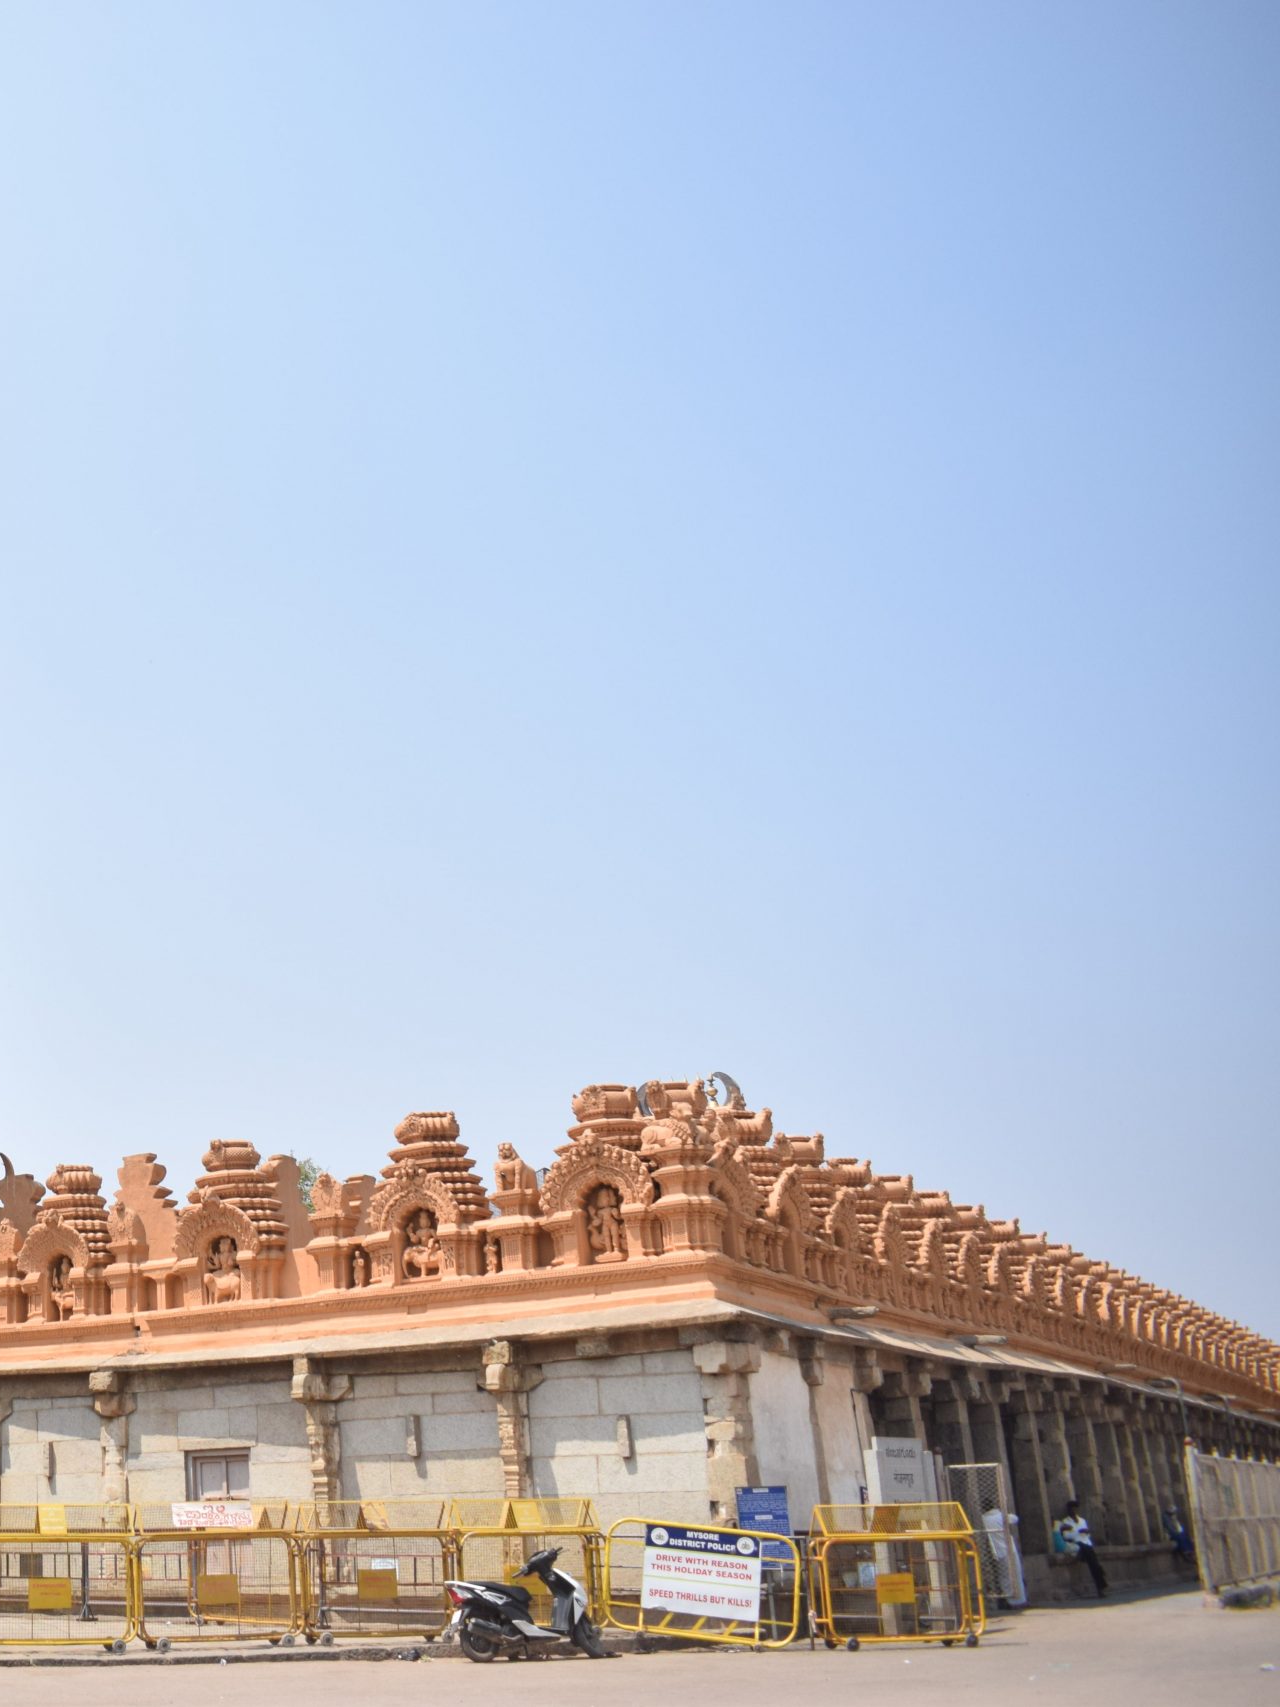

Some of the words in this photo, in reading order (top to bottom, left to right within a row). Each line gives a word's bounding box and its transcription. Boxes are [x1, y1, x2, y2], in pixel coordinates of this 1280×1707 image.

[669, 1538, 706, 1549] DISTRICT
[686, 1531, 720, 1541] MYSORE
[655, 1554, 682, 1563] DRIVE
[685, 1557, 708, 1566] WITH
[711, 1560, 748, 1570] REASON
[651, 1563, 672, 1571] THIS
[674, 1566, 713, 1576] HOLIDAY
[715, 1570, 752, 1580] SEASON
[649, 1589, 674, 1598] SPEED
[676, 1592, 708, 1603] THRILLS
[710, 1595, 725, 1604] BUT
[727, 1598, 752, 1608] KILLS!
